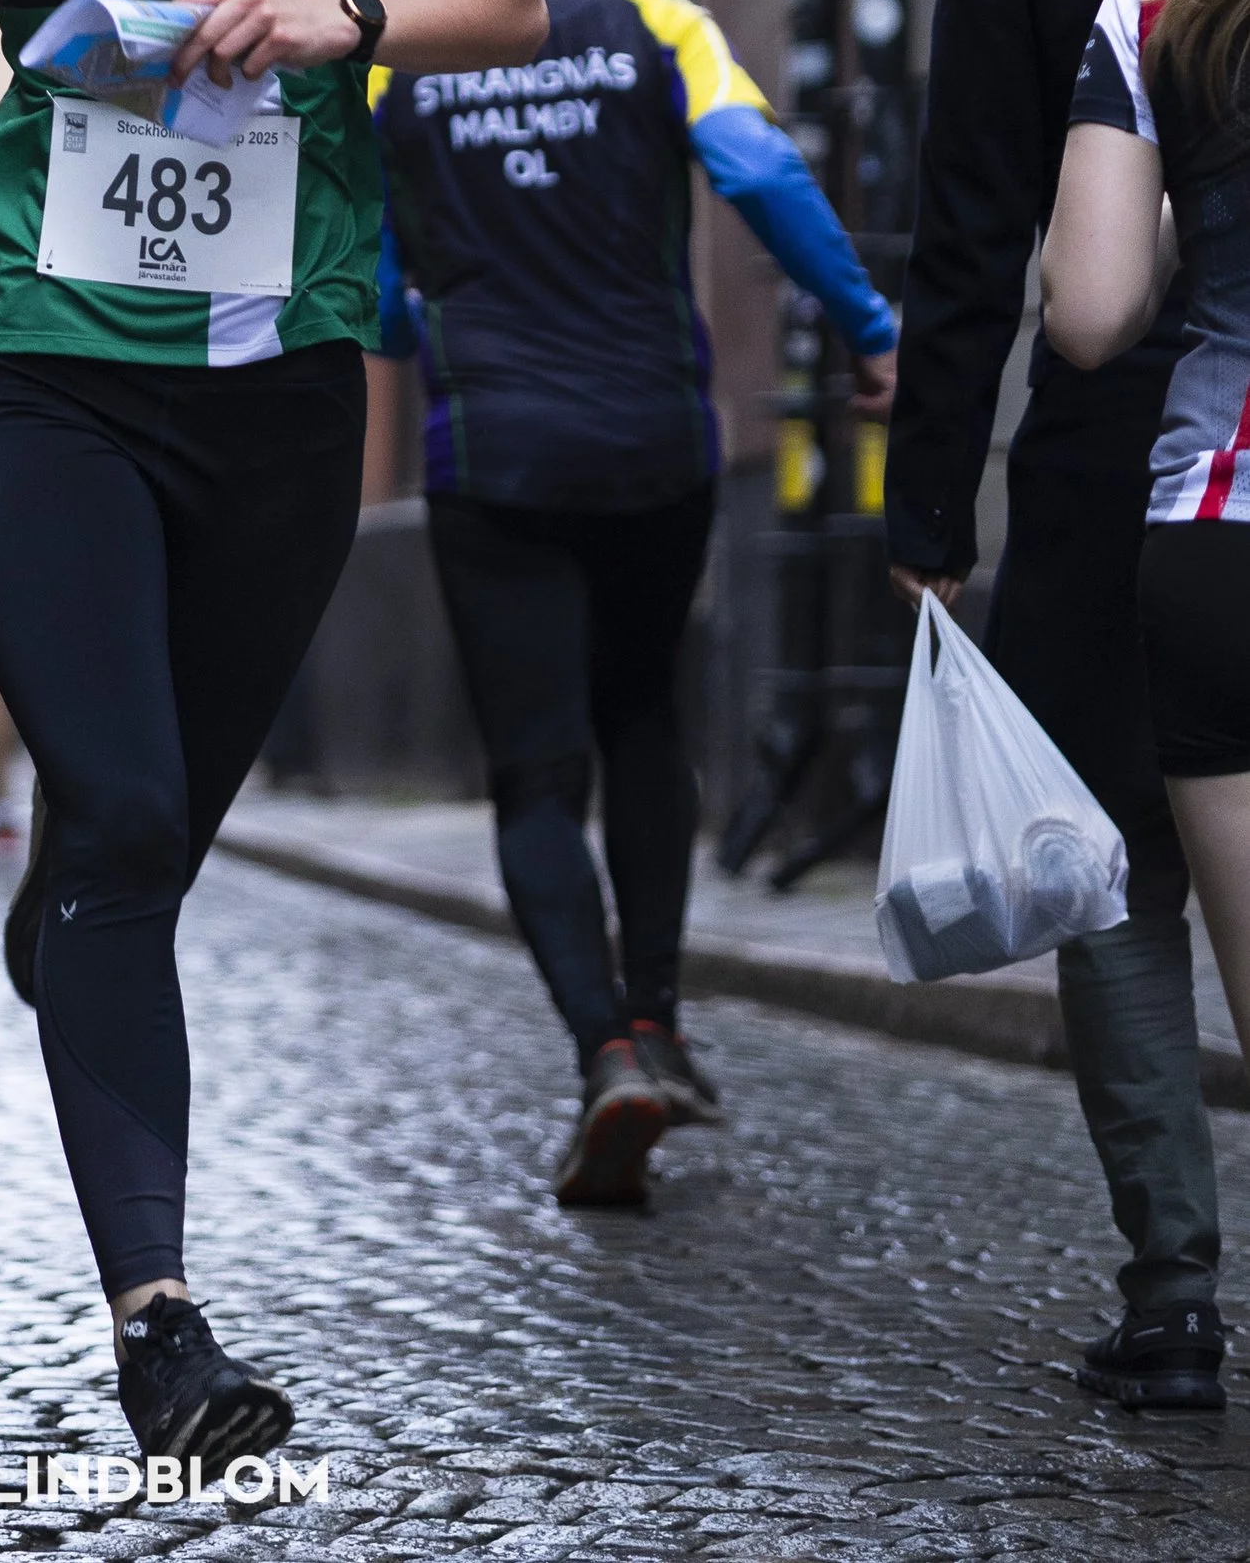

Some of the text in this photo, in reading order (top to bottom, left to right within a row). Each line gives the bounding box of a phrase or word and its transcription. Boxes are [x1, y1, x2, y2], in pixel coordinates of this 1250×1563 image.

[248, 131, 278, 145] 2025
[450, 98, 600, 151] MALMBY
[102, 153, 232, 235] 483
[139, 235, 187, 263] ICA
[161, 262, 187, 273] nära
